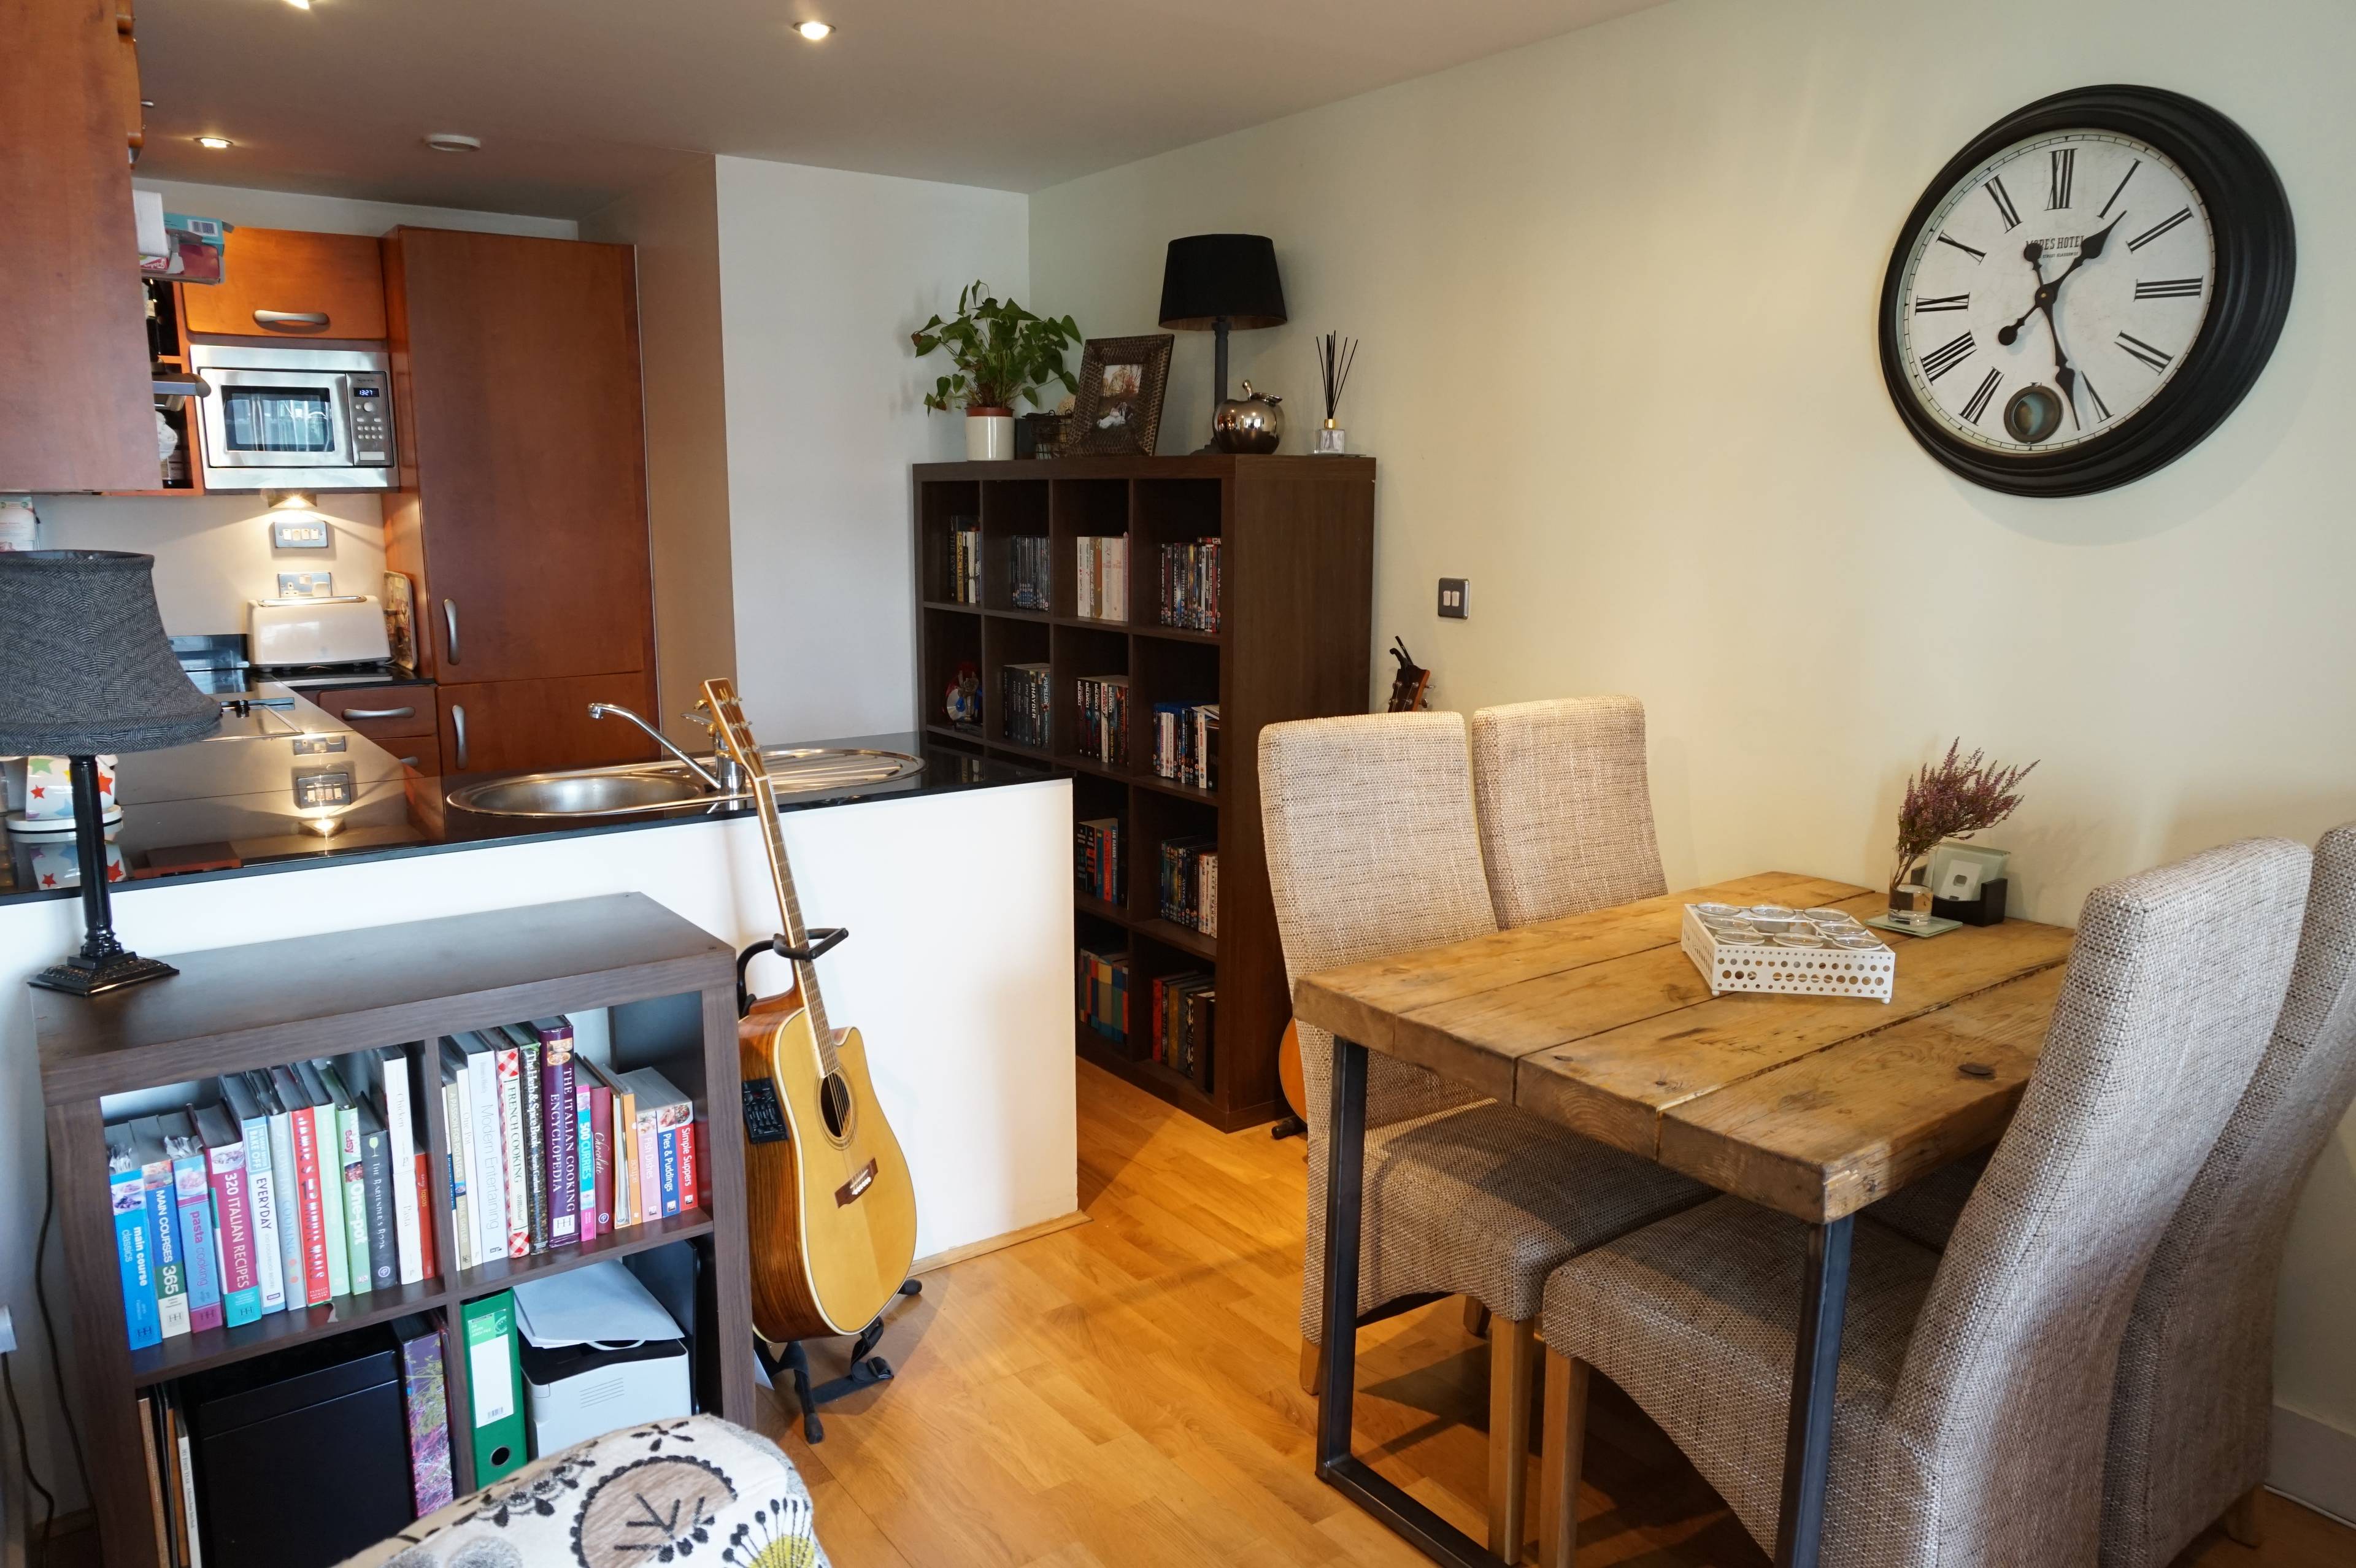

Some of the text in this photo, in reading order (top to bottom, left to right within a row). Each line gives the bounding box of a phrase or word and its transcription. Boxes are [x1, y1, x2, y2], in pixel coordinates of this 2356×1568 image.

[2044, 148, 2078, 210] XII
[2126, 205, 2194, 253] II
[2134, 275, 2203, 301] III
[2081, 370, 2114, 423] V
[396, 1093, 406, 1128] Chicken
[451, 1099, 460, 1126] PASSION
[526, 1051, 540, 1148] The Herb & Spice Book
[249, 1130, 262, 1168] BAKE OFF
[296, 1117, 315, 1174] JAMIE'S
[344, 1129, 354, 1153] easy
[481, 1104, 496, 1155] Modern
[507, 1086, 522, 1183] FRENCH COOKING
[550, 1093, 561, 1192] ENCYCLOPEDIA
[563, 1067, 576, 1213] THE ITALIAN COOKING
[580, 1122, 592, 1180] 500 CURRIES
[663, 1133, 672, 1149] Pies
[454, 1142, 463, 1178] POTATOES
[594, 1131, 609, 1175] Chocolate
[644, 1137, 655, 1179] Fish Dishes
[680, 1127, 693, 1186] Simple Suppers
[225, 1174, 238, 1196] 320
[483, 1158, 501, 1229] Entertaining
[663, 1158, 674, 1192] Puddings
[156, 1189, 167, 1216] MAIN
[228, 1198, 245, 1243] ITALIAN
[256, 1178, 272, 1230] EVERYDAY
[304, 1202, 321, 1242] MINUTE
[350, 1183, 368, 1245] One-pot
[372, 1163, 387, 1250] THE BARTENDER'S BOOK
[403, 1205, 412, 1227] Pasta
[121, 1229, 134, 1262] classics
[134, 1226, 144, 1251] main
[159, 1218, 173, 1263] COURSES
[190, 1211, 205, 1243] pasta
[282, 1200, 296, 1255] COOKING
[136, 1253, 148, 1286] course
[162, 1265, 179, 1295] 365
[196, 1247, 209, 1286] cooking
[233, 1245, 250, 1289] RECIPES
[308, 1244, 325, 1280] MEALS
